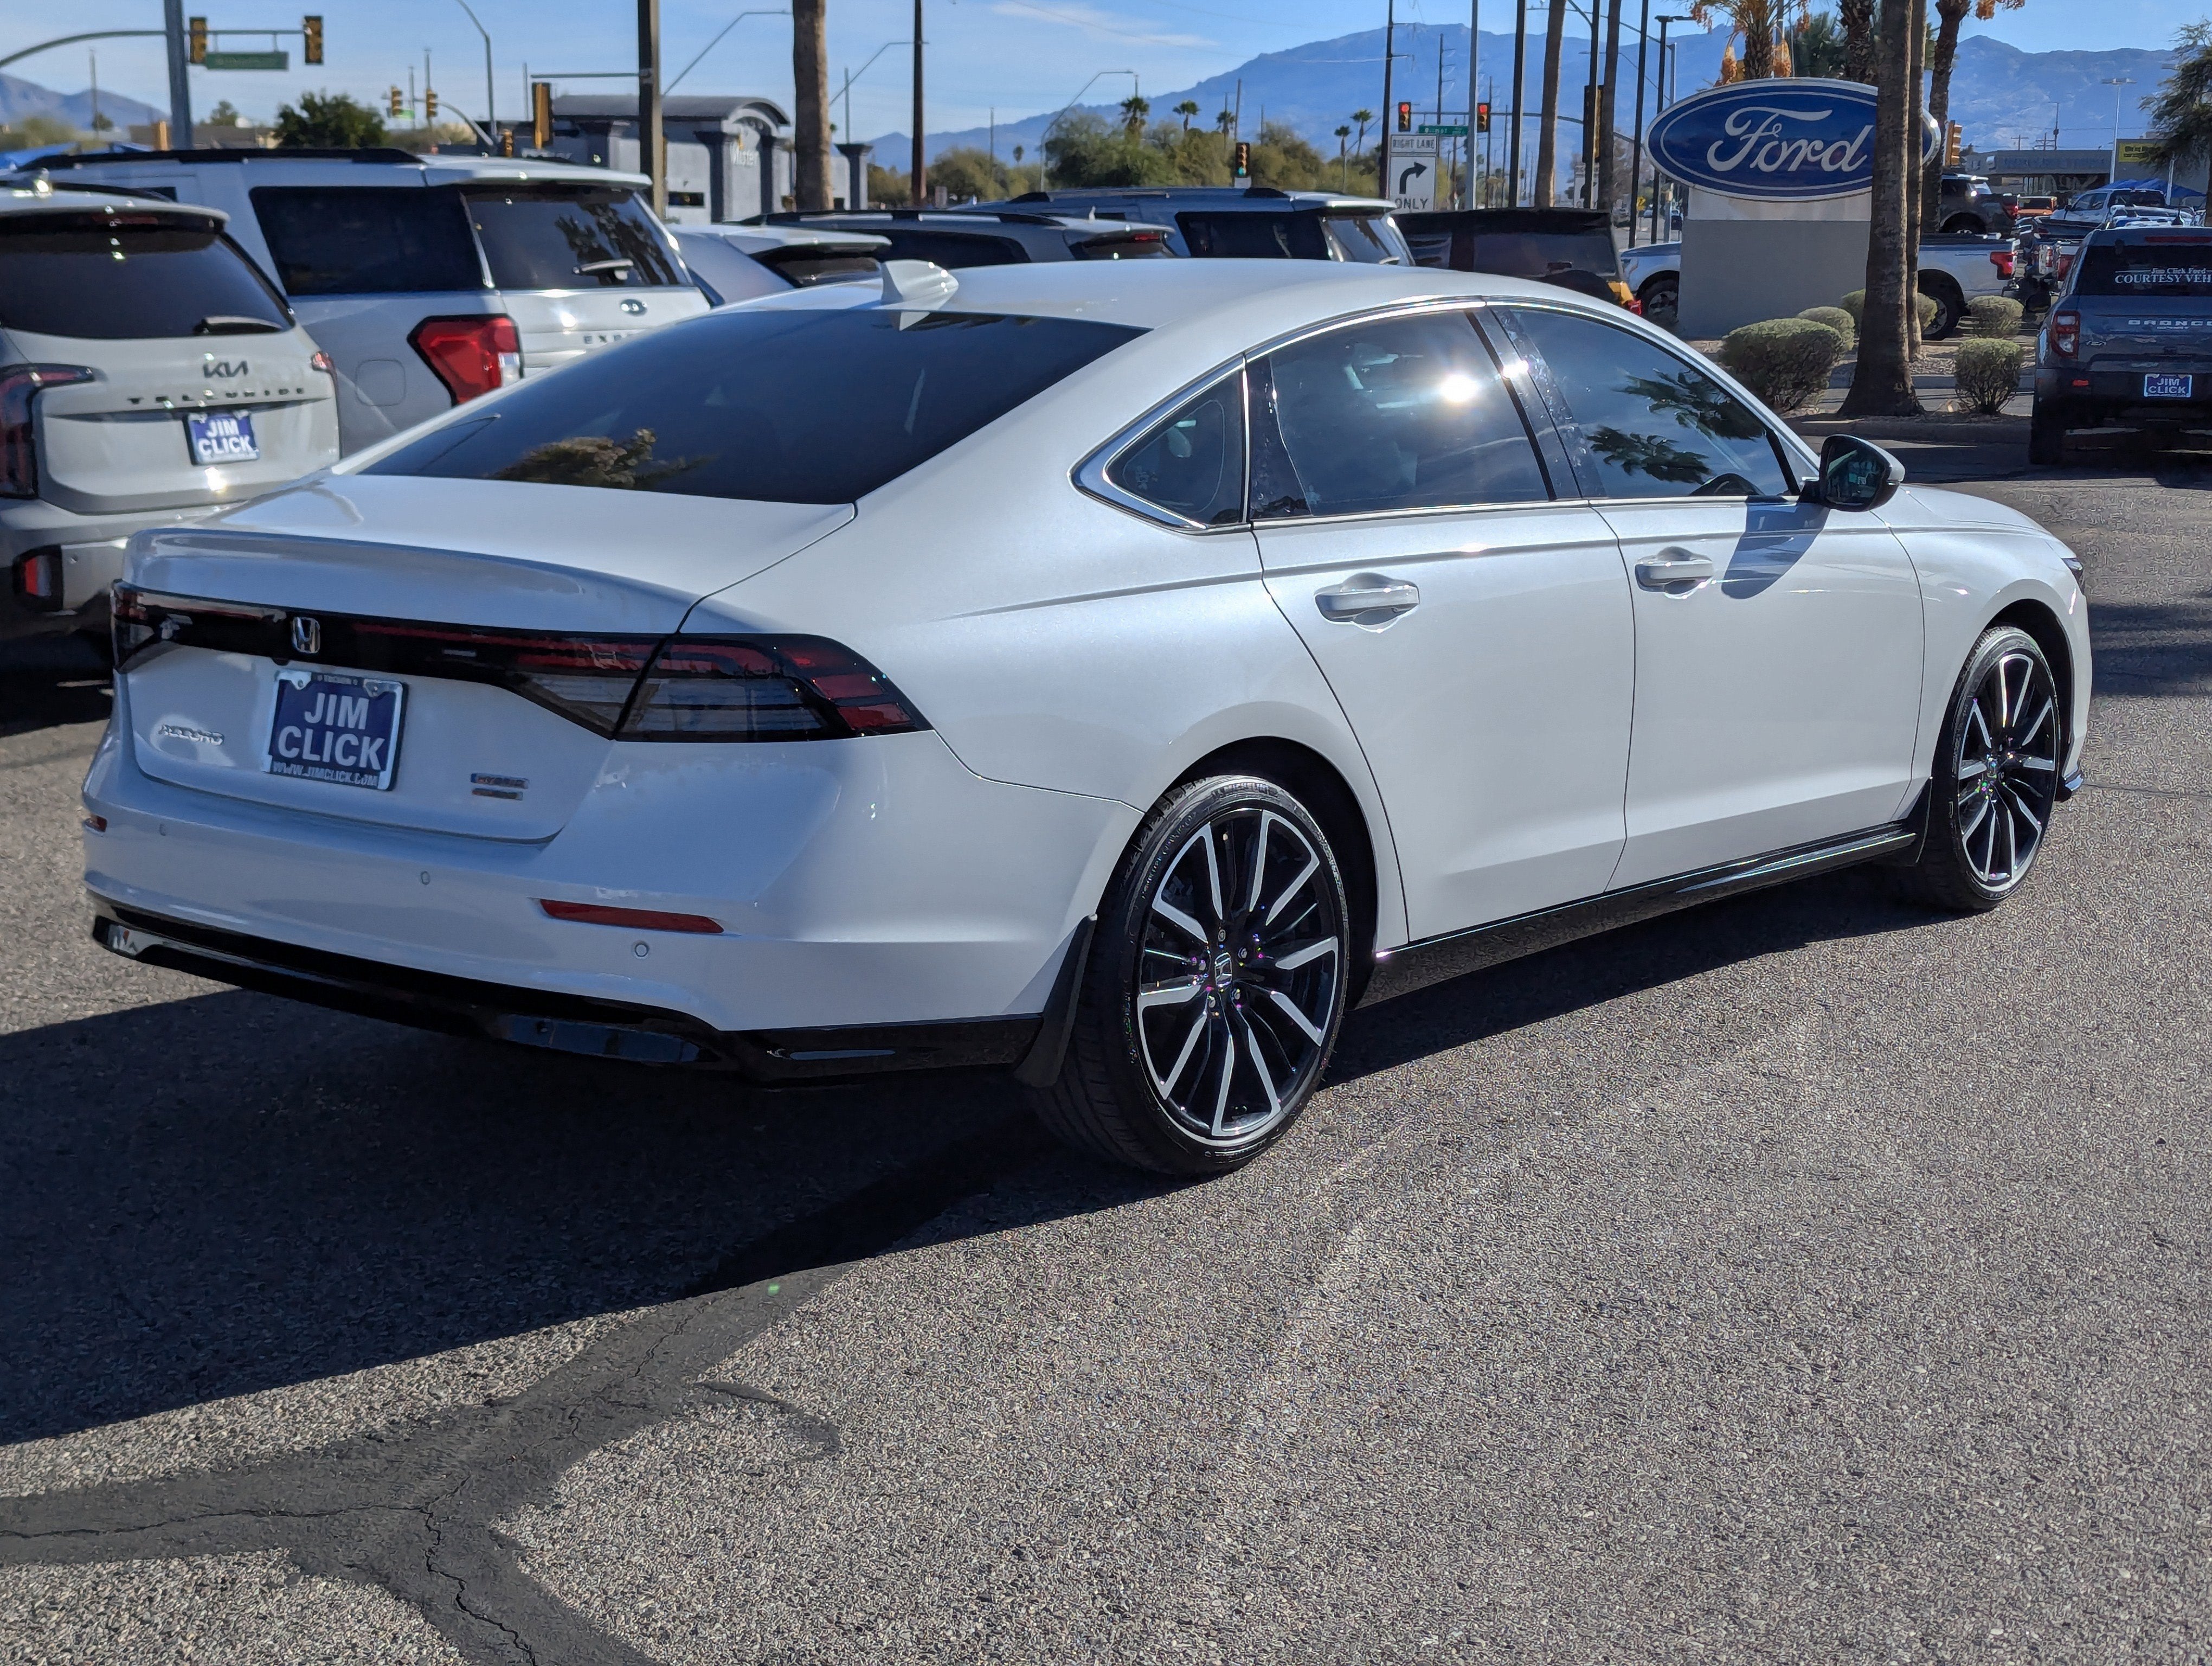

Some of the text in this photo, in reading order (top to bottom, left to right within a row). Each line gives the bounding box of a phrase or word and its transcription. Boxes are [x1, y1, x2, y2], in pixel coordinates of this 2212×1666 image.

[1393, 139, 1435, 149] RIGHT LANE
[1707, 106, 1874, 172] Ford
[1394, 198, 1428, 209] ONLY
[2114, 274, 2182, 284] COURTESY
[583, 333, 633, 344] EXP
[203, 360, 249, 378] KIA
[2148, 386, 2187, 394] CLICK
[206, 419, 239, 438] JIM
[198, 435, 254, 456] CLICK
[304, 692, 369, 730] JIM
[278, 726, 385, 771] CLICK
